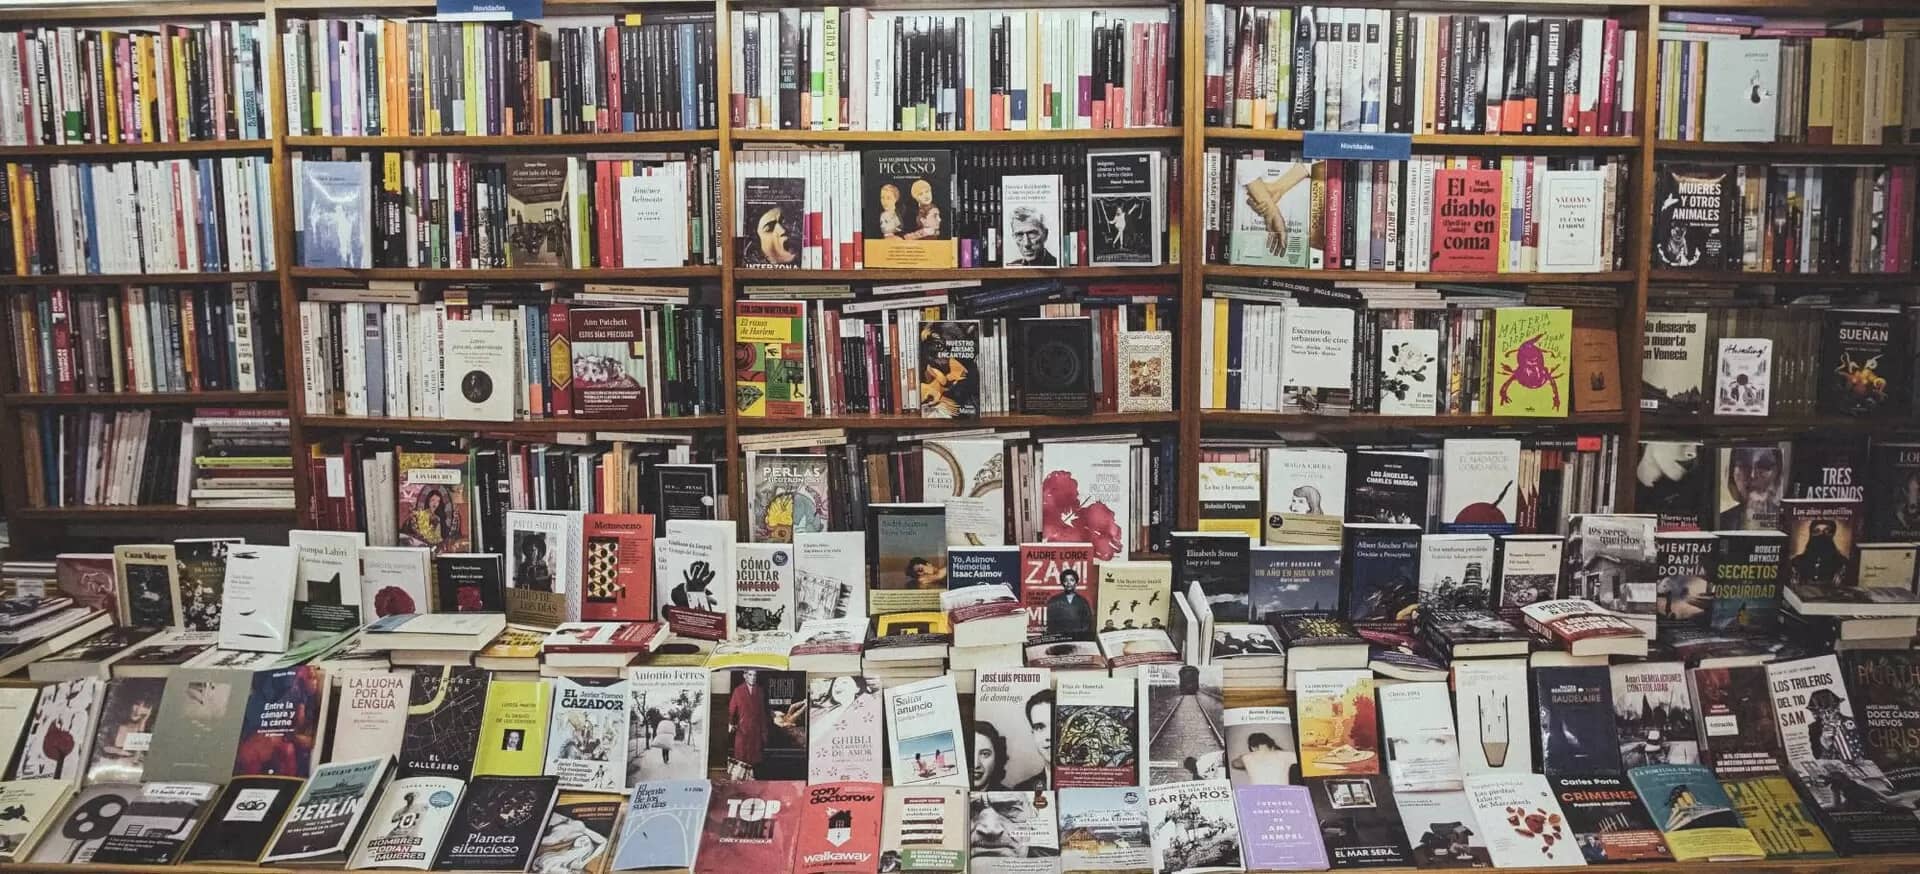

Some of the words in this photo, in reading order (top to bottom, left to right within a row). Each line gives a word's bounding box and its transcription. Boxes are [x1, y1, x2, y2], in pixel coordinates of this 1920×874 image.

[826, 19, 835, 47] CULPA
[825, 50, 833, 62] LA
[1439, 109, 1446, 117] EL
[878, 161, 936, 175] PICASSO
[1447, 178, 1465, 196] El
[1475, 179, 1490, 187] Mark
[1679, 183, 1722, 195] MUJERES
[1681, 196, 1689, 207] Y
[1690, 197, 1721, 208] OTROS
[1441, 199, 1496, 217] diablo
[1673, 209, 1720, 221] ANIMALES
[1387, 211, 1396, 243] BRUTUS
[1474, 220, 1495, 233] en
[1443, 235, 1490, 250] coma
[583, 318, 598, 326] Ann
[599, 317, 628, 326] Patchett
[740, 319, 749, 327] El
[1500, 313, 1549, 334] MATERIA
[1655, 320, 1696, 333] desearás
[579, 331, 594, 339] ESTOS
[595, 330, 606, 338] DÍAS
[740, 327, 749, 336] de
[750, 327, 775, 336] Harlem
[1291, 327, 1332, 336] Escenarios
[1839, 327, 1889, 342] SUEÑAN
[1291, 335, 1321, 344] urbanos
[1322, 335, 1332, 344] de
[1333, 336, 1350, 345] cine
[1653, 348, 1687, 361] Venecia
[763, 467, 821, 478] PERLAS
[1370, 470, 1382, 479] LOS
[1383, 470, 1408, 480] ÁNGELES
[1822, 467, 1852, 485] TRES
[1366, 477, 1392, 485] CHARLES
[1393, 479, 1418, 487] MANSON
[1806, 486, 1864, 501] ASESINOS
[1793, 508, 1804, 516] Los
[1821, 507, 1853, 516] amarillos
[513, 520, 534, 529] PATTI
[1601, 527, 1627, 537] seres
[1600, 536, 1641, 546] queridos
[324, 545, 348, 556] Lahiri
[1186, 549, 1217, 557] Elizabeth
[1656, 543, 1713, 553] MIENTRAS
[1754, 545, 1781, 554] ROBERT
[124, 551, 144, 559] Caza
[144, 551, 168, 561] Mayor
[953, 556, 964, 564] Yo,
[1026, 551, 1057, 561] AUDRE
[1059, 550, 1089, 560] LORDE
[1668, 553, 1699, 565] PARÍS
[740, 557, 771, 570] CÓMO
[953, 563, 991, 571] Memorias
[953, 570, 973, 578] Isaac
[973, 570, 1003, 578] Asimov
[1025, 561, 1088, 585] ZAMI
[1255, 569, 1265, 577] UN
[1267, 568, 1281, 577] AÑO
[1282, 569, 1293, 577] EN
[1293, 569, 1316, 577] NUEVA
[1317, 569, 1335, 577] YORK
[1659, 564, 1706, 576] DORMÍA
[1718, 565, 1778, 579] SECRETOS
[1716, 584, 1776, 598] OSCURIDAD
[1027, 607, 1048, 626] MI
[633, 671, 672, 680] Antonio
[674, 670, 705, 680] Ferres
[980, 672, 998, 684] JOSÉ
[998, 672, 1012, 683] LUÍS
[1015, 673, 1041, 683] PEIXOTO
[349, 678, 363, 688] LA
[366, 679, 403, 689] LUCHA
[1773, 680, 1790, 693] LOS
[1791, 673, 1833, 690] TRILEROS
[564, 689, 578, 698] EL
[980, 684, 1010, 693] Comida
[354, 689, 377, 698] POR
[380, 689, 395, 699] LA
[980, 694, 988, 702] de
[988, 694, 1023, 703] domingo
[1552, 694, 1601, 703] BAUDELAIRE
[264, 702, 284, 711] Entre
[285, 701, 294, 709] la
[351, 699, 395, 709] LENGUA
[562, 698, 624, 711] CAZADOR
[897, 701, 933, 716] anuncio
[1777, 697, 1792, 710] DEL
[260, 709, 288, 719] cámara
[1781, 711, 1806, 727] SAM
[1867, 711, 1893, 719] DOCE
[1893, 711, 1920, 719] CASOS
[261, 719, 268, 727] la
[269, 719, 292, 727] carne
[1868, 719, 1903, 727] NUEVOS
[832, 736, 872, 745] GHIBLI
[408, 761, 460, 771] CALLEJERO
[1560, 778, 1593, 786] Carles
[811, 787, 841, 797] cory
[1561, 790, 1637, 802] CRÍMENES
[810, 794, 875, 805] doctorow
[1150, 790, 1230, 806] BÁRBAROS
[293, 795, 360, 822] BERLÍN
[727, 798, 781, 822] TOP
[368, 837, 423, 847] HOMBRES
[467, 833, 516, 844] Planeta
[1261, 833, 1304, 841] HEMPEL
[451, 843, 519, 854] silencioso
[1335, 850, 1346, 858] EL
[1347, 849, 1368, 857] MAR
[374, 852, 426, 862] MUJERES
[804, 851, 871, 863] walkaway
